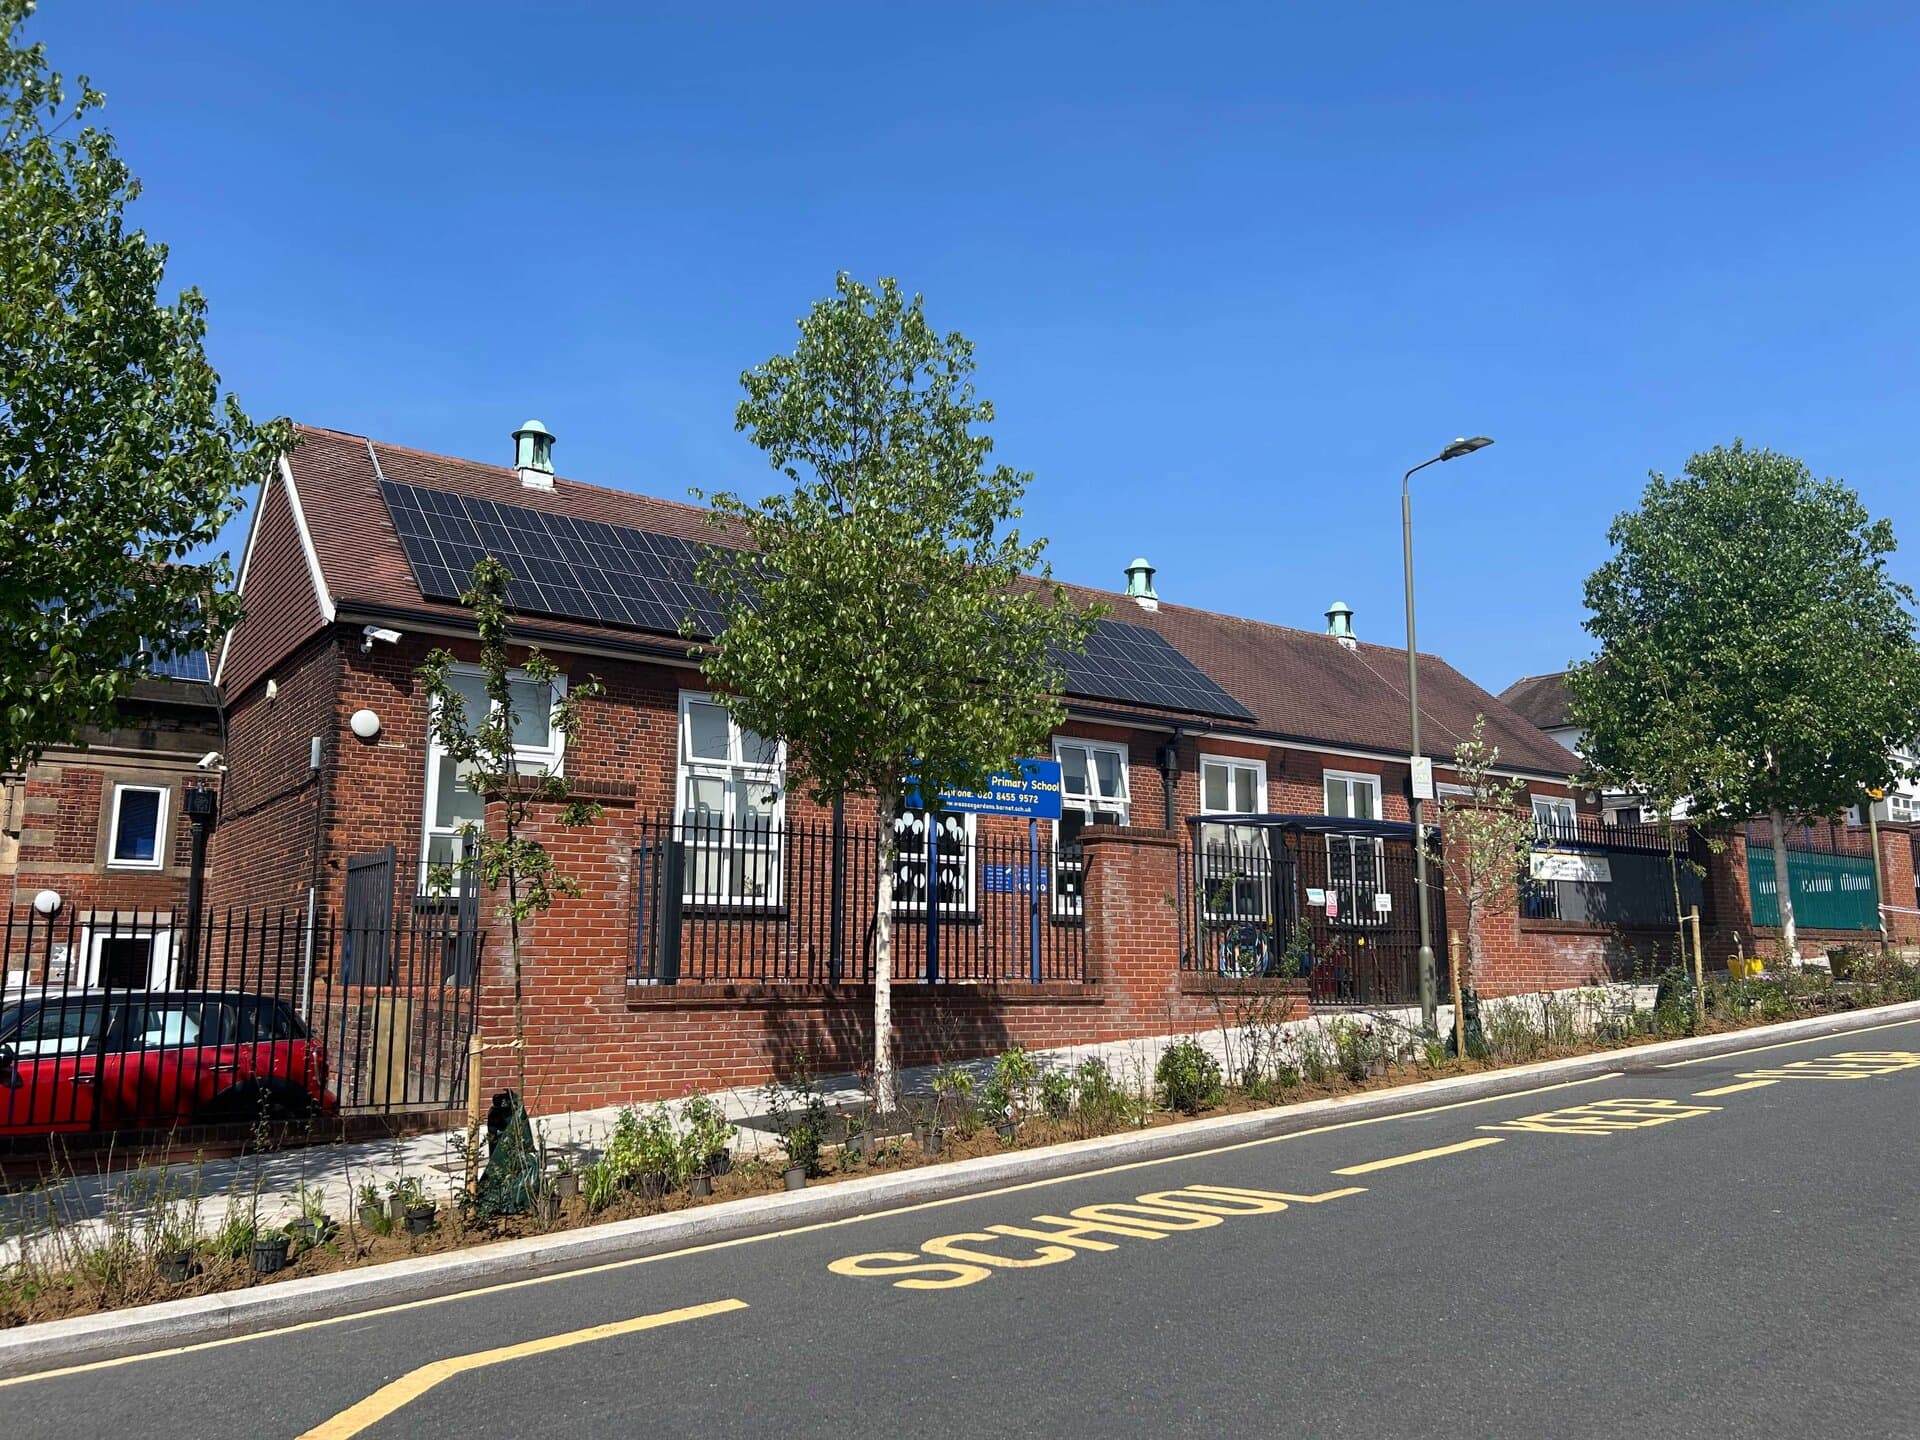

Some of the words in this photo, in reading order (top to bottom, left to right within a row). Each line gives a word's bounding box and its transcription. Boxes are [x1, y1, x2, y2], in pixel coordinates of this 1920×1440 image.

[992, 776, 1027, 790] Primary
[1031, 780, 1060, 792] School
[977, 790, 992, 799] 020
[996, 793, 1016, 802] 8455
[1018, 794, 1039, 803] 9572
[827, 1185, 1368, 1289] SCHOOL
[1474, 1098, 1724, 1135] KEEP
